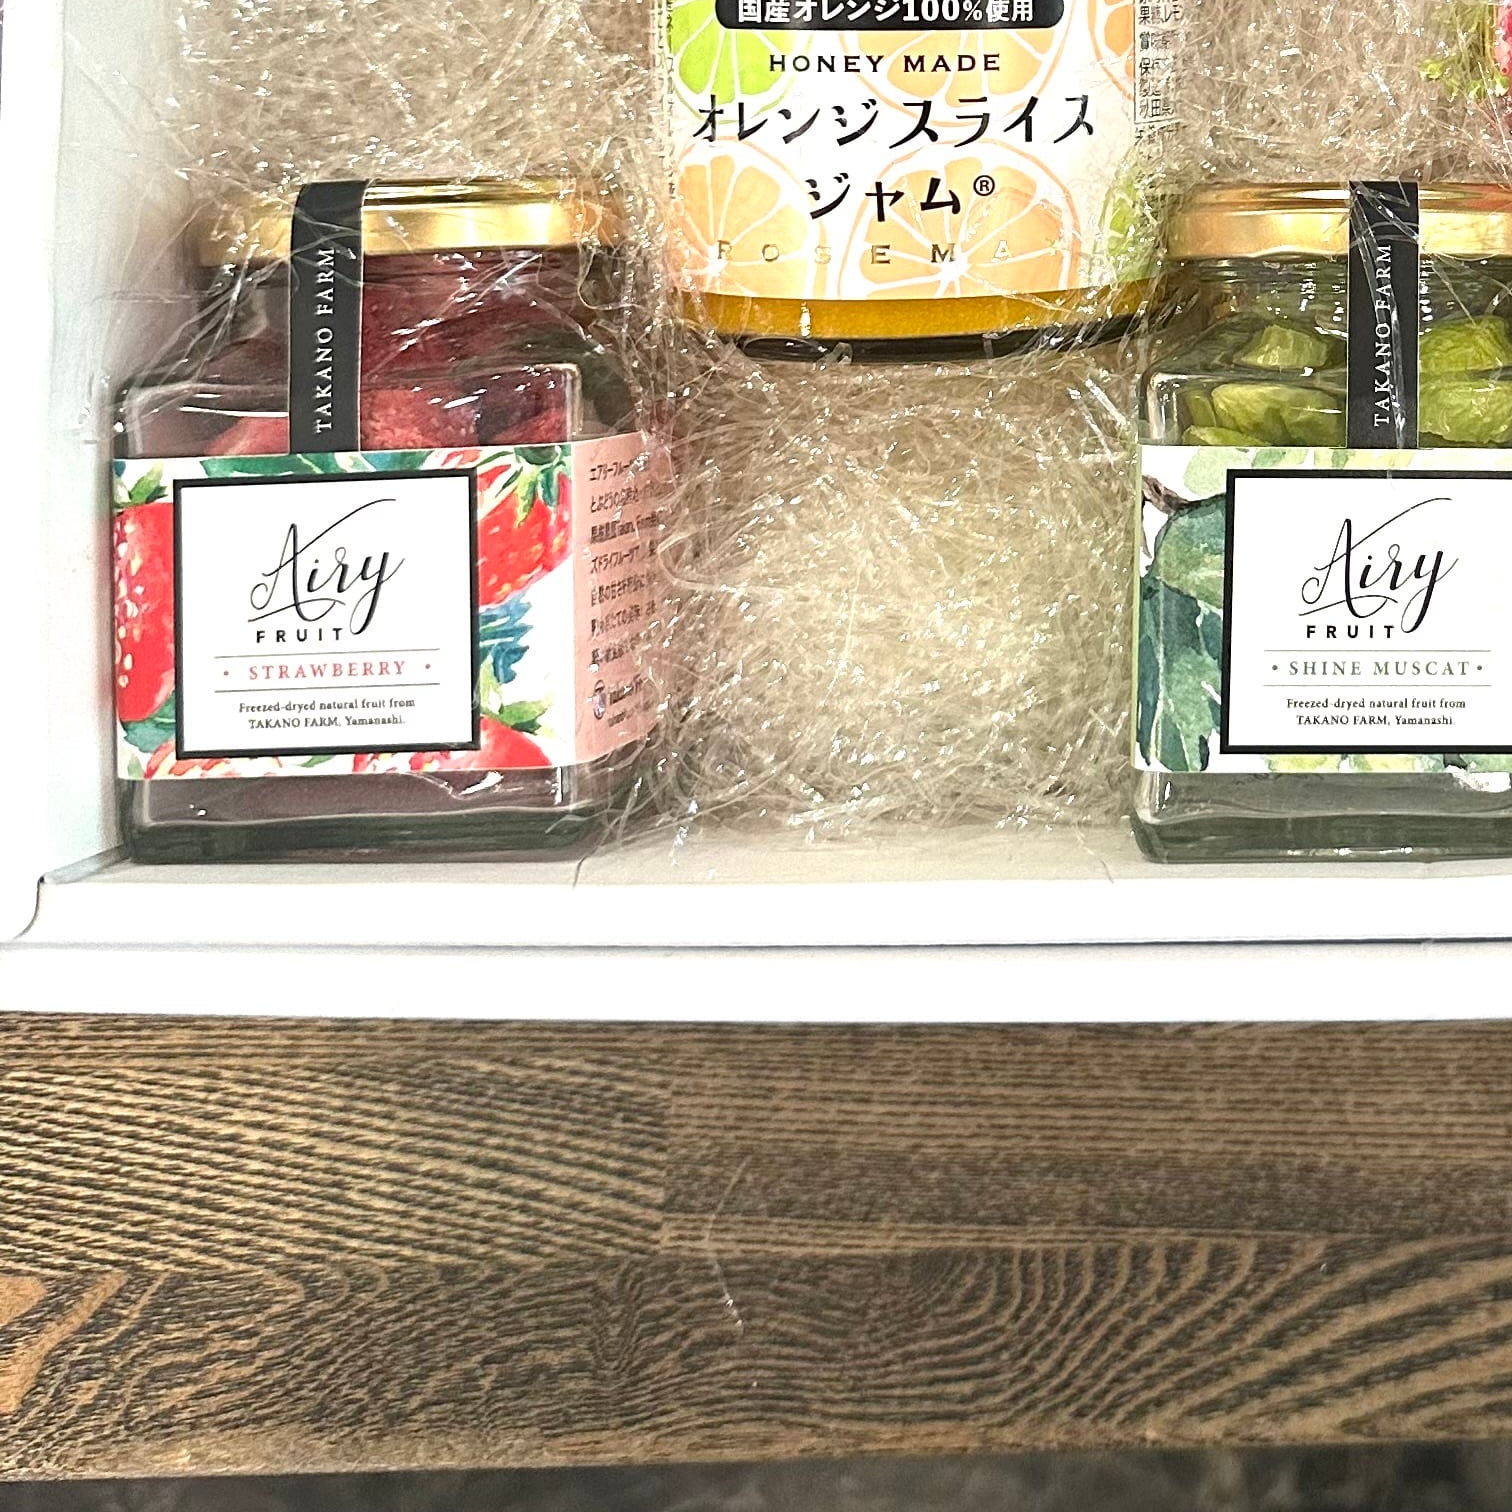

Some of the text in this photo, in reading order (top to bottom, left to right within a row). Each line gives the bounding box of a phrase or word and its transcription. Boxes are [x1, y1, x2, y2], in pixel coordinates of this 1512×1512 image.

[769, 53, 1001, 73] HONEY MADE
[692, 93, 1096, 149] オレンジスライス
[313, 246, 336, 434] TAKANO FARM
[1374, 244, 1393, 427] TAKANO FARM
[248, 499, 404, 635] Airy
[1298, 498, 1460, 634] Airy
[256, 628, 343, 643] FRUIT
[1306, 625, 1395, 639] FRUIT
[248, 661, 406, 680] STRAWBERRY
[1289, 660, 1470, 676] SHINE MUSCAT
[319, 699, 358, 710] natural
[361, 698, 386, 709] fruit
[389, 697, 415, 708] from
[1369, 698, 1408, 708] natural
[1411, 698, 1437, 708] fruit
[1439, 698, 1466, 708] from
[249, 718, 300, 729] TAKANO
[304, 717, 342, 727] FARM,
[1296, 715, 1349, 725] TAKANO
[1353, 715, 1391, 727] FARM,
